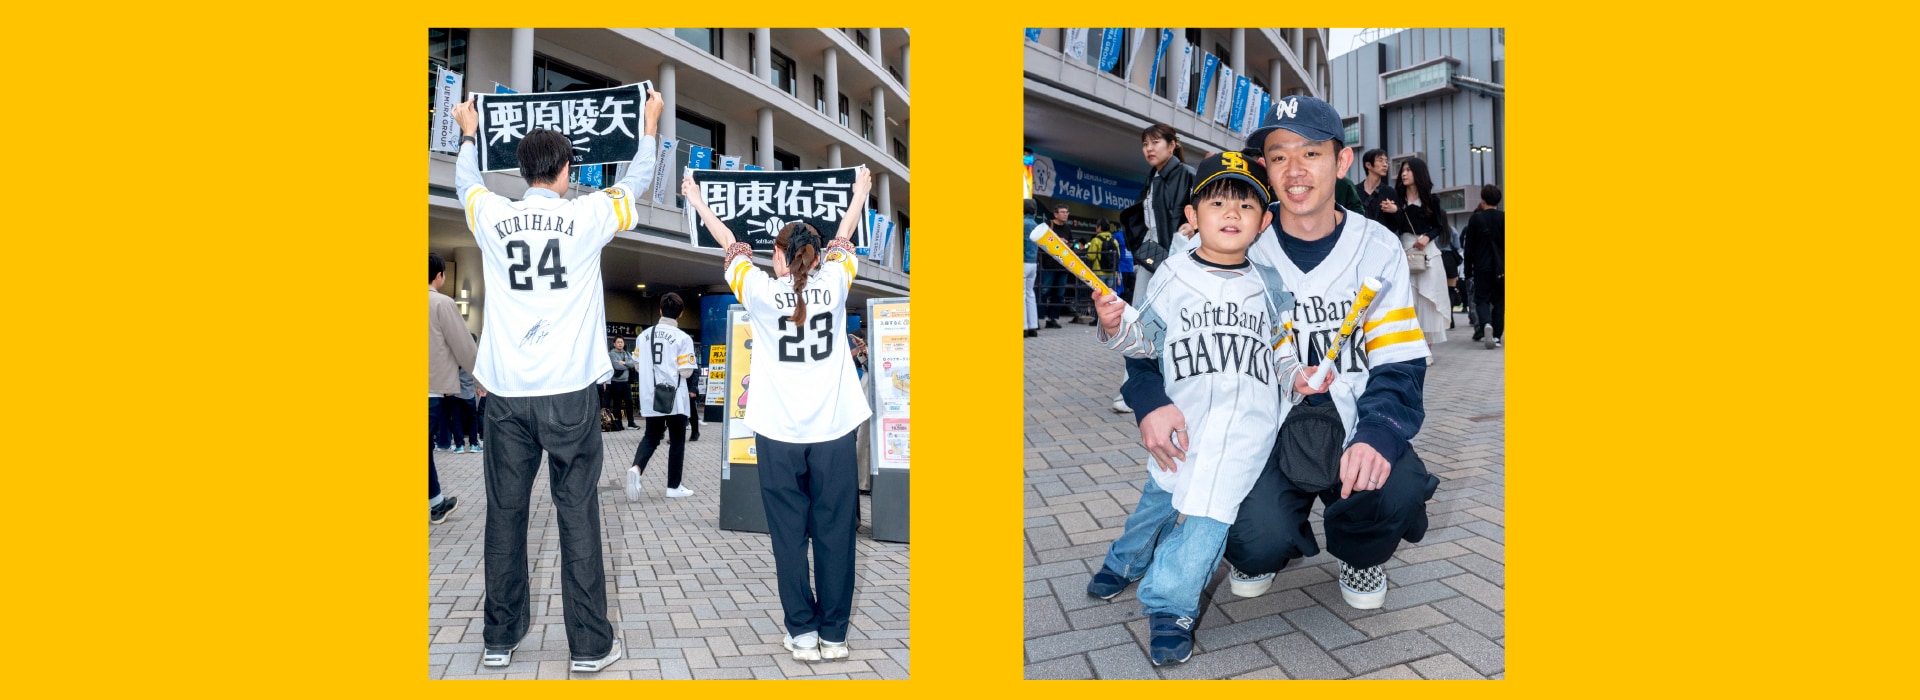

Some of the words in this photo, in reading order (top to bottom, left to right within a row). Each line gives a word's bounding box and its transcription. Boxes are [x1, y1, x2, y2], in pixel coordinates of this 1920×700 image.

[442, 85, 451, 118] UEMURA
[440, 119, 449, 147] GROUP
[486, 96, 637, 146] 栗原陵矢
[699, 177, 851, 227] 周東佑京
[1059, 180, 1091, 200] Make
[1091, 184, 1103, 206] U
[1104, 190, 1136, 209] Happy
[494, 214, 575, 240] KURIHARA
[506, 238, 569, 291] 24
[778, 310, 834, 363] 23
[1180, 301, 1266, 338] SoftBank
[653, 342, 664, 365] 8
[1169, 332, 1272, 386] HAWKS
[1176, 615, 1194, 630] N
